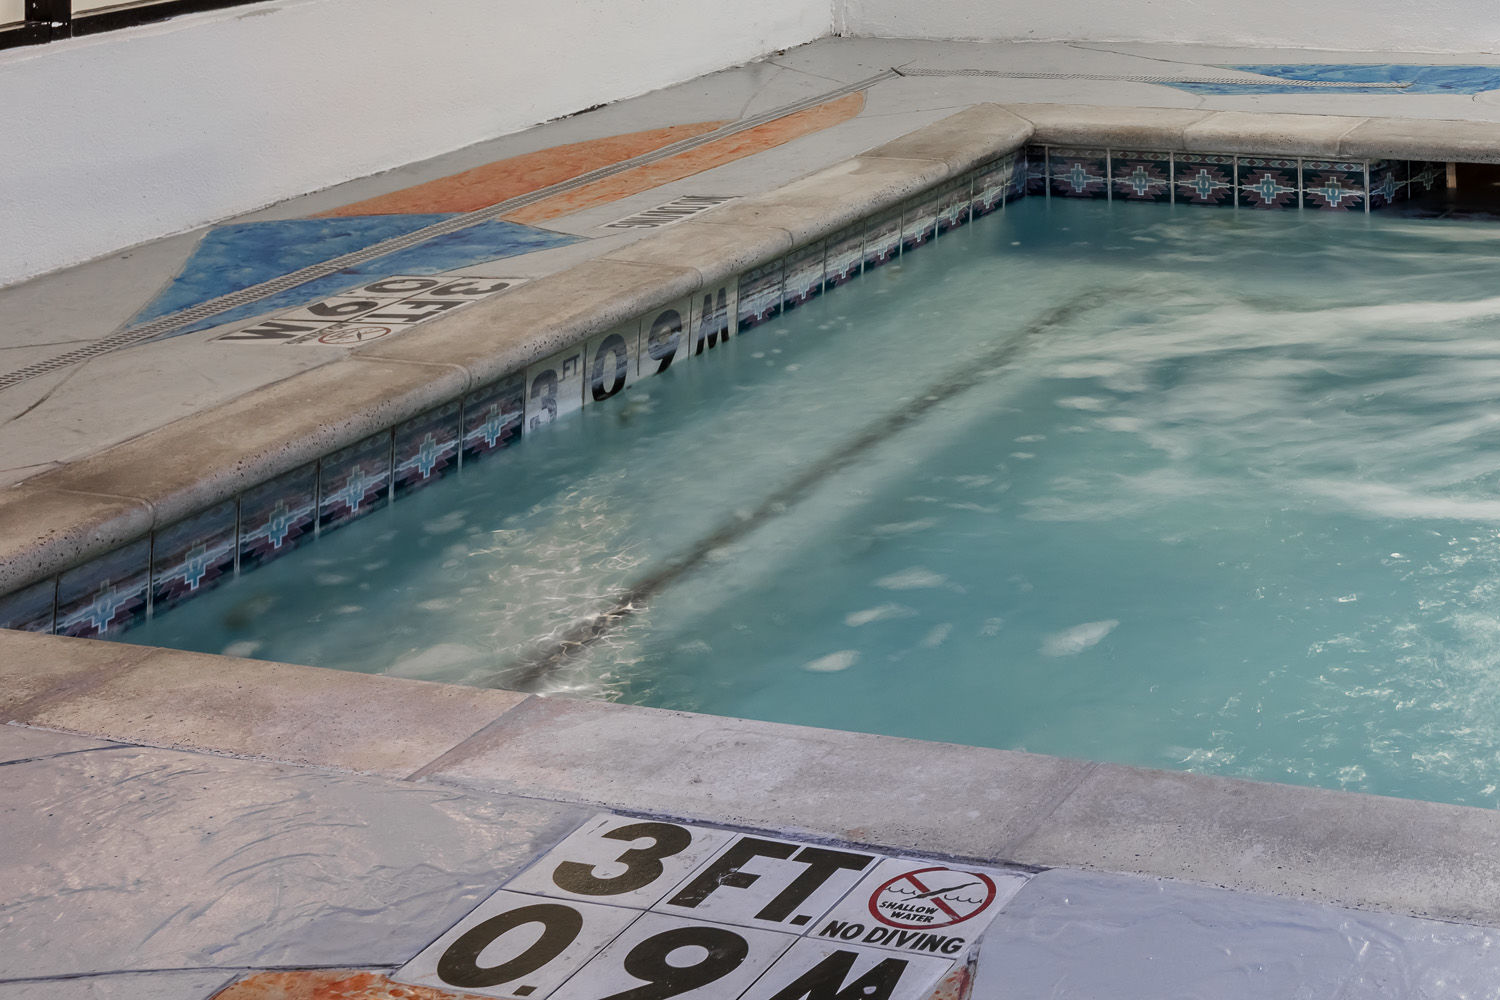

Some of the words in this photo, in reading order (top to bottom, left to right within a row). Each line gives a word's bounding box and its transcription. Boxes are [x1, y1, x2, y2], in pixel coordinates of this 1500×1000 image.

[429, 282, 511, 296] 3
[218, 321, 321, 341] M
[529, 369, 558, 430] 3
[562, 353, 581, 382] FT
[695, 287, 730, 357] M
[553, 822, 693, 896] 3
[879, 900, 940, 915] SHALLOW
[890, 911, 935, 924] WATER
[817, 920, 866, 941] NO
[861, 926, 966, 954] DIVING
